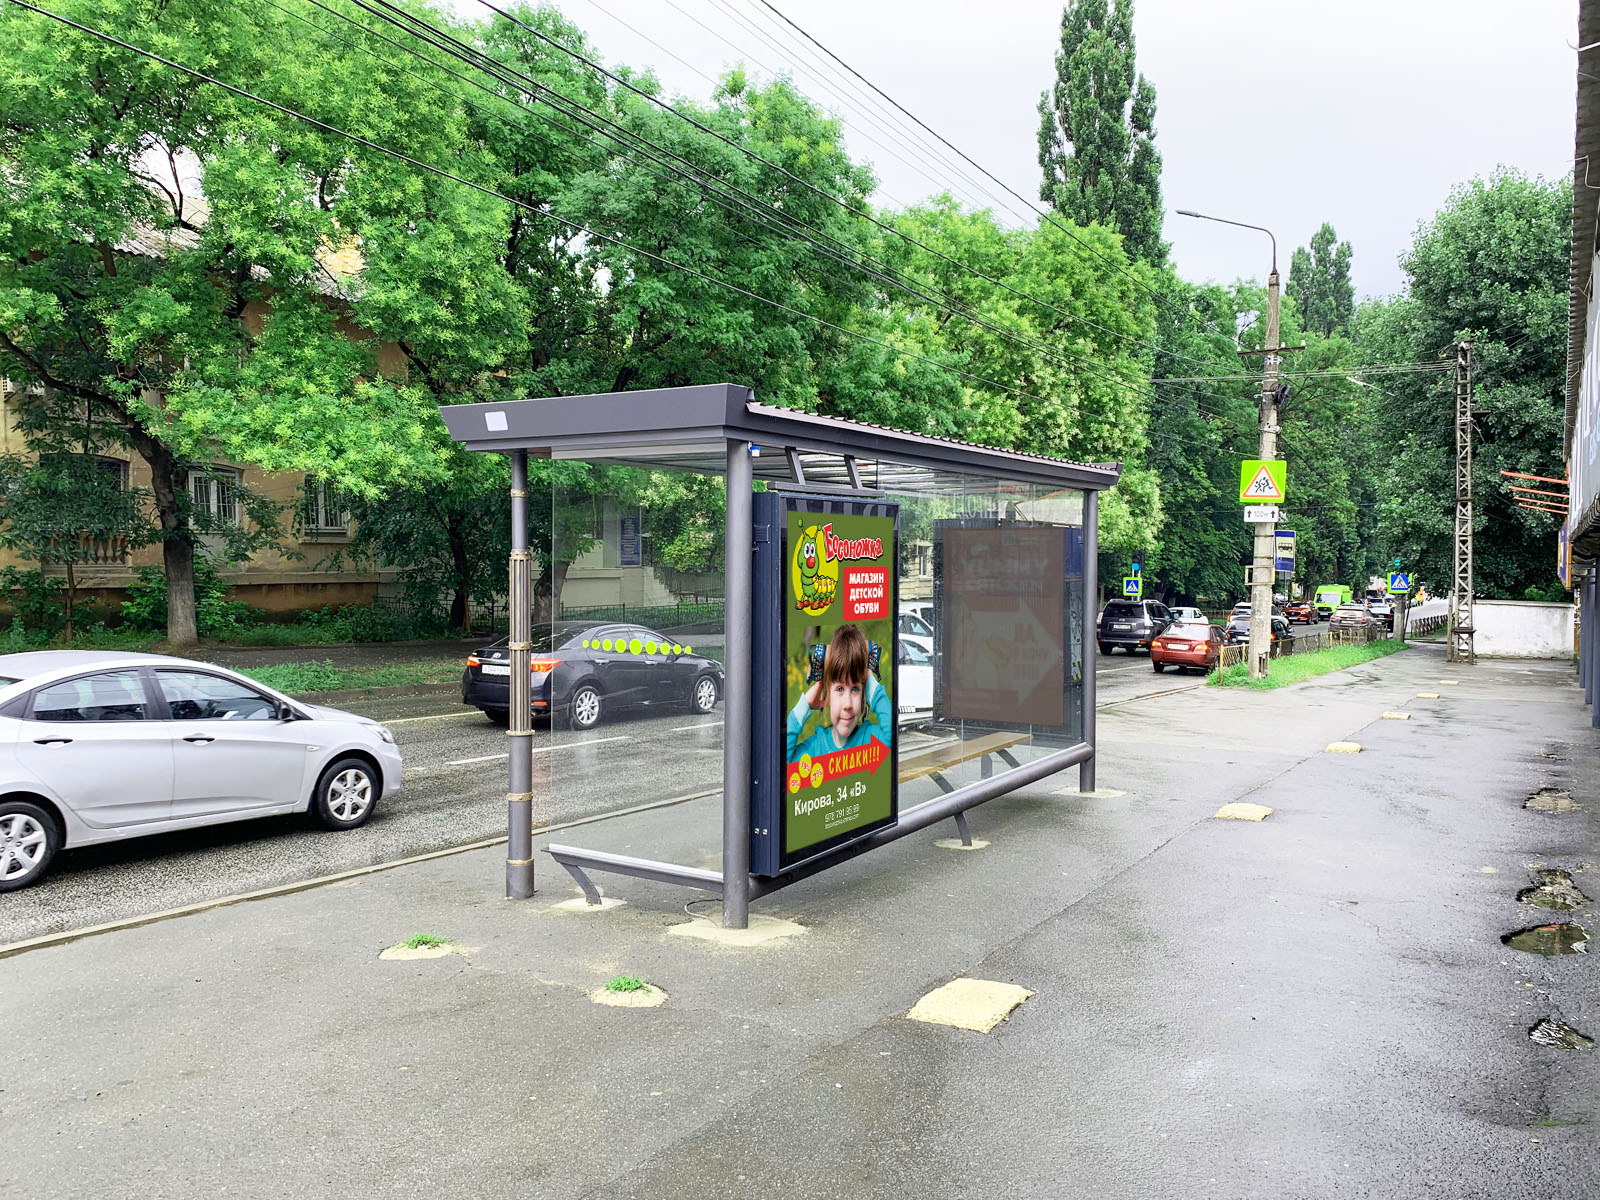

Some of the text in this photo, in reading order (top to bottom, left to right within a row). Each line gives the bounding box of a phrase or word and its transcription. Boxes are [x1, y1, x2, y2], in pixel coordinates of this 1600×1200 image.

[822, 522, 883, 561] Босоножка
[849, 572, 884, 584] МАГАЗИН
[849, 585, 884, 601] ДЕТСКОЙ
[854, 602, 879, 614] ОБУВИ
[828, 745, 880, 775] СКИДКИ!!!
[794, 782, 866, 817] Кирова, 34 «В»
[836, 808, 845, 819] 791
